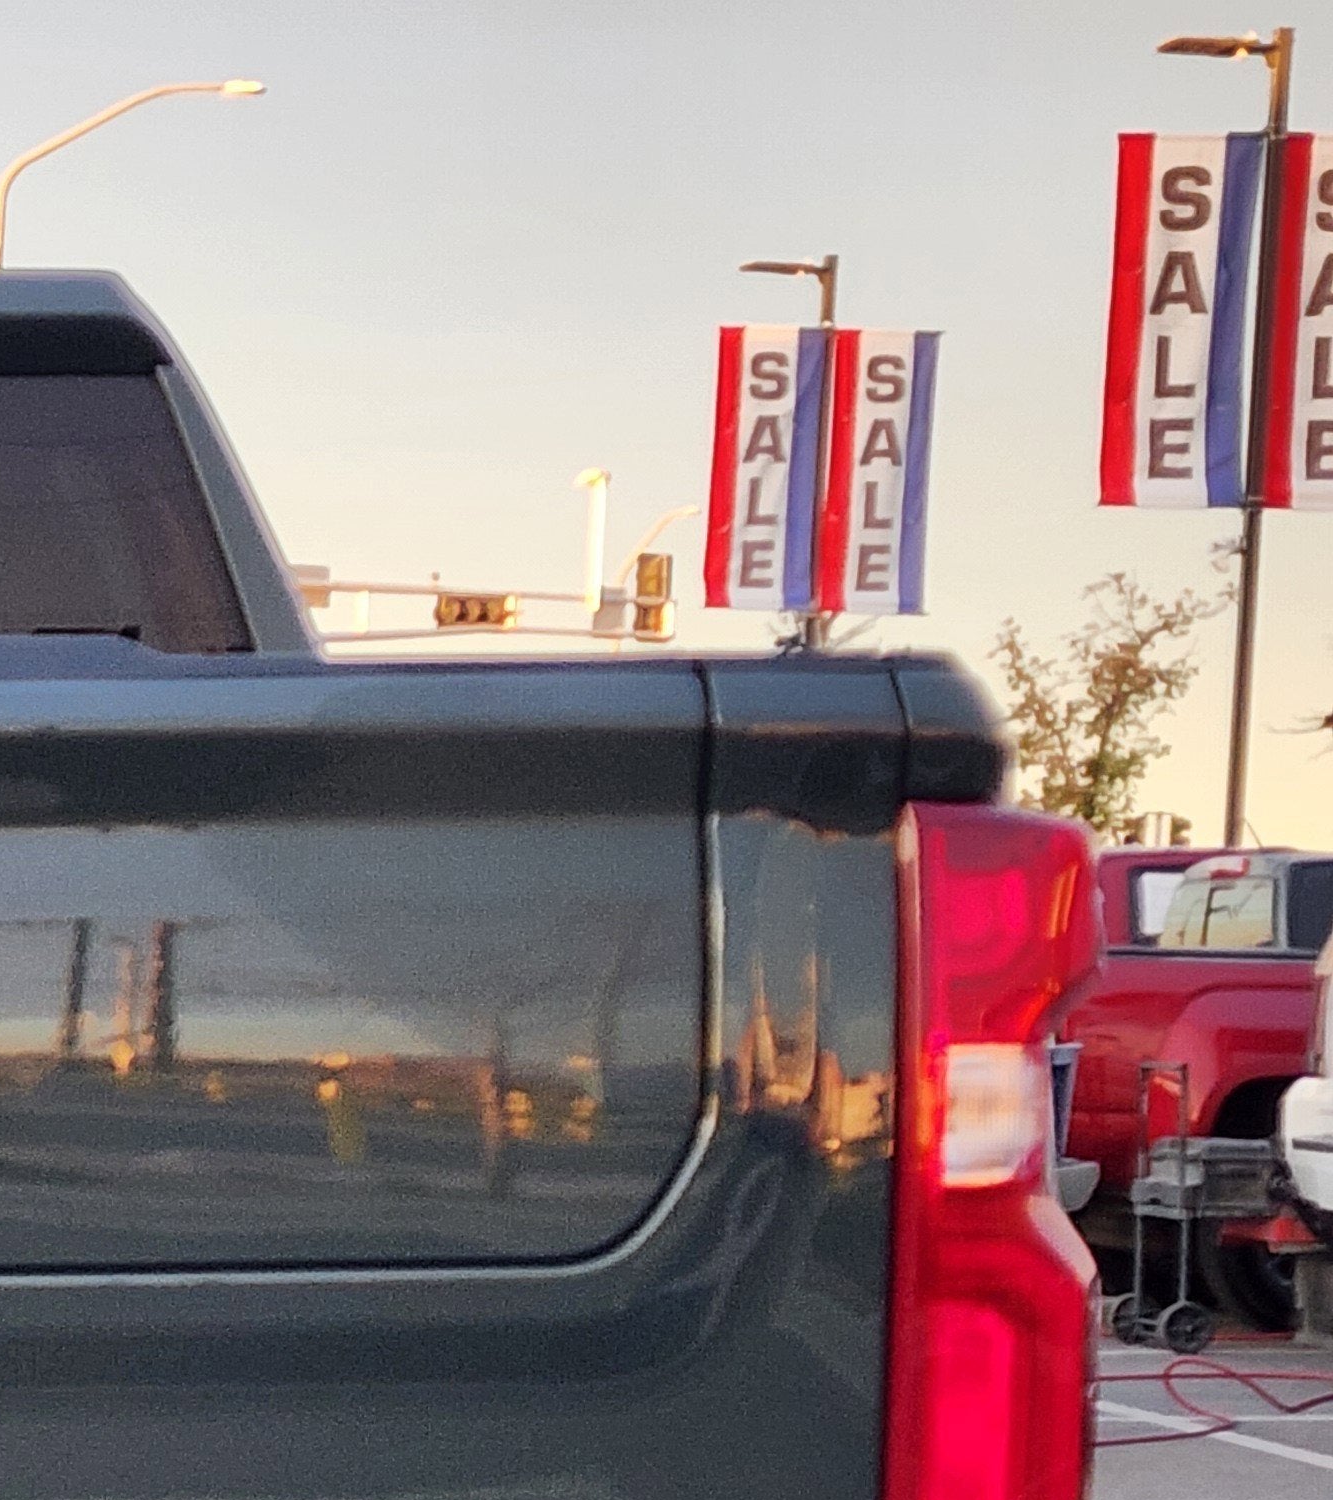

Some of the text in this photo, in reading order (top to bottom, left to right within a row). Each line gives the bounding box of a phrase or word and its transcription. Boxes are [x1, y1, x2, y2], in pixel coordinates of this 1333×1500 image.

[1148, 165, 1213, 480] SALE
[739, 351, 790, 588] SALE
[855, 354, 907, 592] SALE
